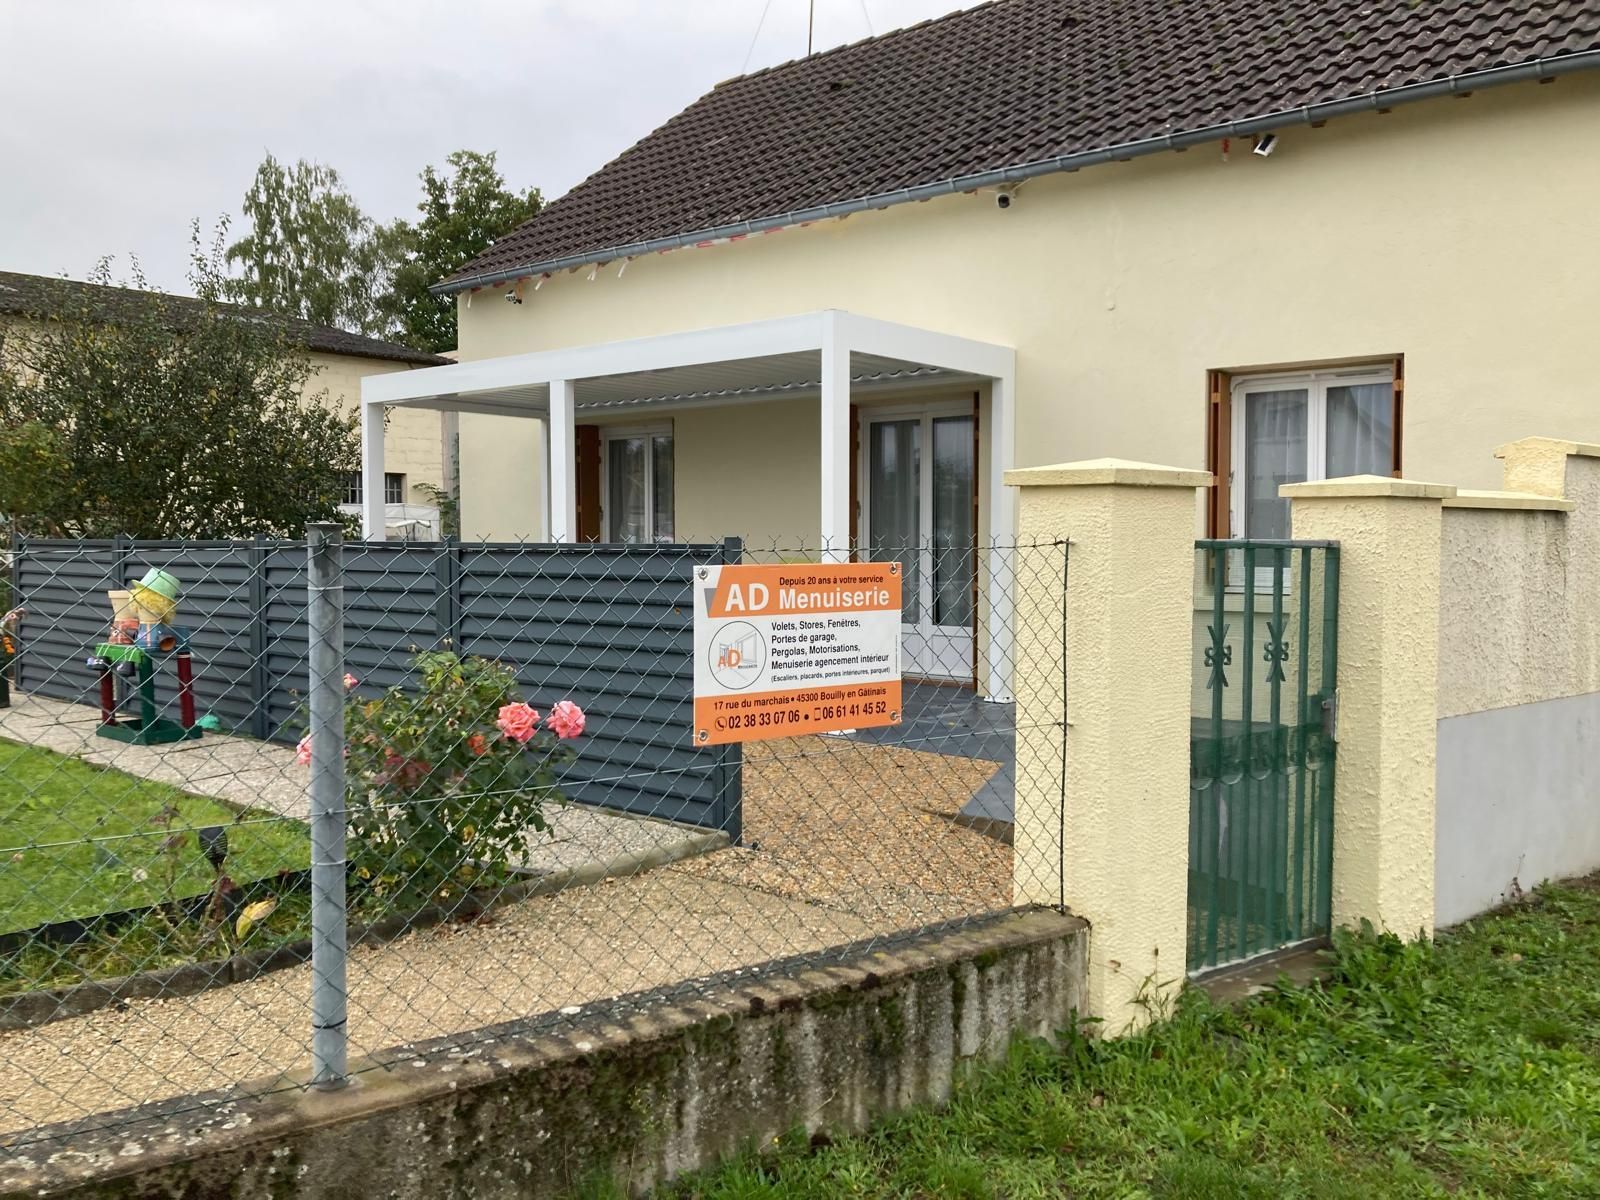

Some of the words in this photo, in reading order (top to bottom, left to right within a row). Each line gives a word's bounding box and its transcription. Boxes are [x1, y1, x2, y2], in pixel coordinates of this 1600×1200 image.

[780, 576, 806, 587] Depuis
[808, 577, 816, 585] 20
[858, 575, 884, 583] service
[724, 582, 770, 612] AD
[779, 586, 890, 610] Menuiserie
[772, 622, 798, 631] Volets,
[800, 620, 826, 630] Stores,
[772, 635, 796, 644] Portes
[798, 634, 808, 642] de
[810, 634, 837, 644] garage,
[772, 647, 808, 658] Pergolas,
[809, 644, 860, 654] Motorisations,
[772, 660, 812, 670] Menuiserie
[814, 656, 858, 668] agencement
[714, 701, 724, 710] 17
[725, 701, 740, 710] rue
[741, 699, 752, 708] du
[754, 696, 790, 706] marchais
[796, 692, 818, 702] 45300
[820, 690, 846, 700] Bouilly
[847, 690, 856, 698] en
[728, 715, 741, 729] 02
[744, 714, 756, 728] 38
[759, 712, 770, 726] 33
[774, 711, 786, 724] 07
[788, 710, 800, 723] 06
[822, 706, 834, 720] 06
[836, 705, 846, 718] 61
[850, 704, 860, 716] 41
[862, 702, 874, 715] 45
[876, 700, 886, 714] 52
